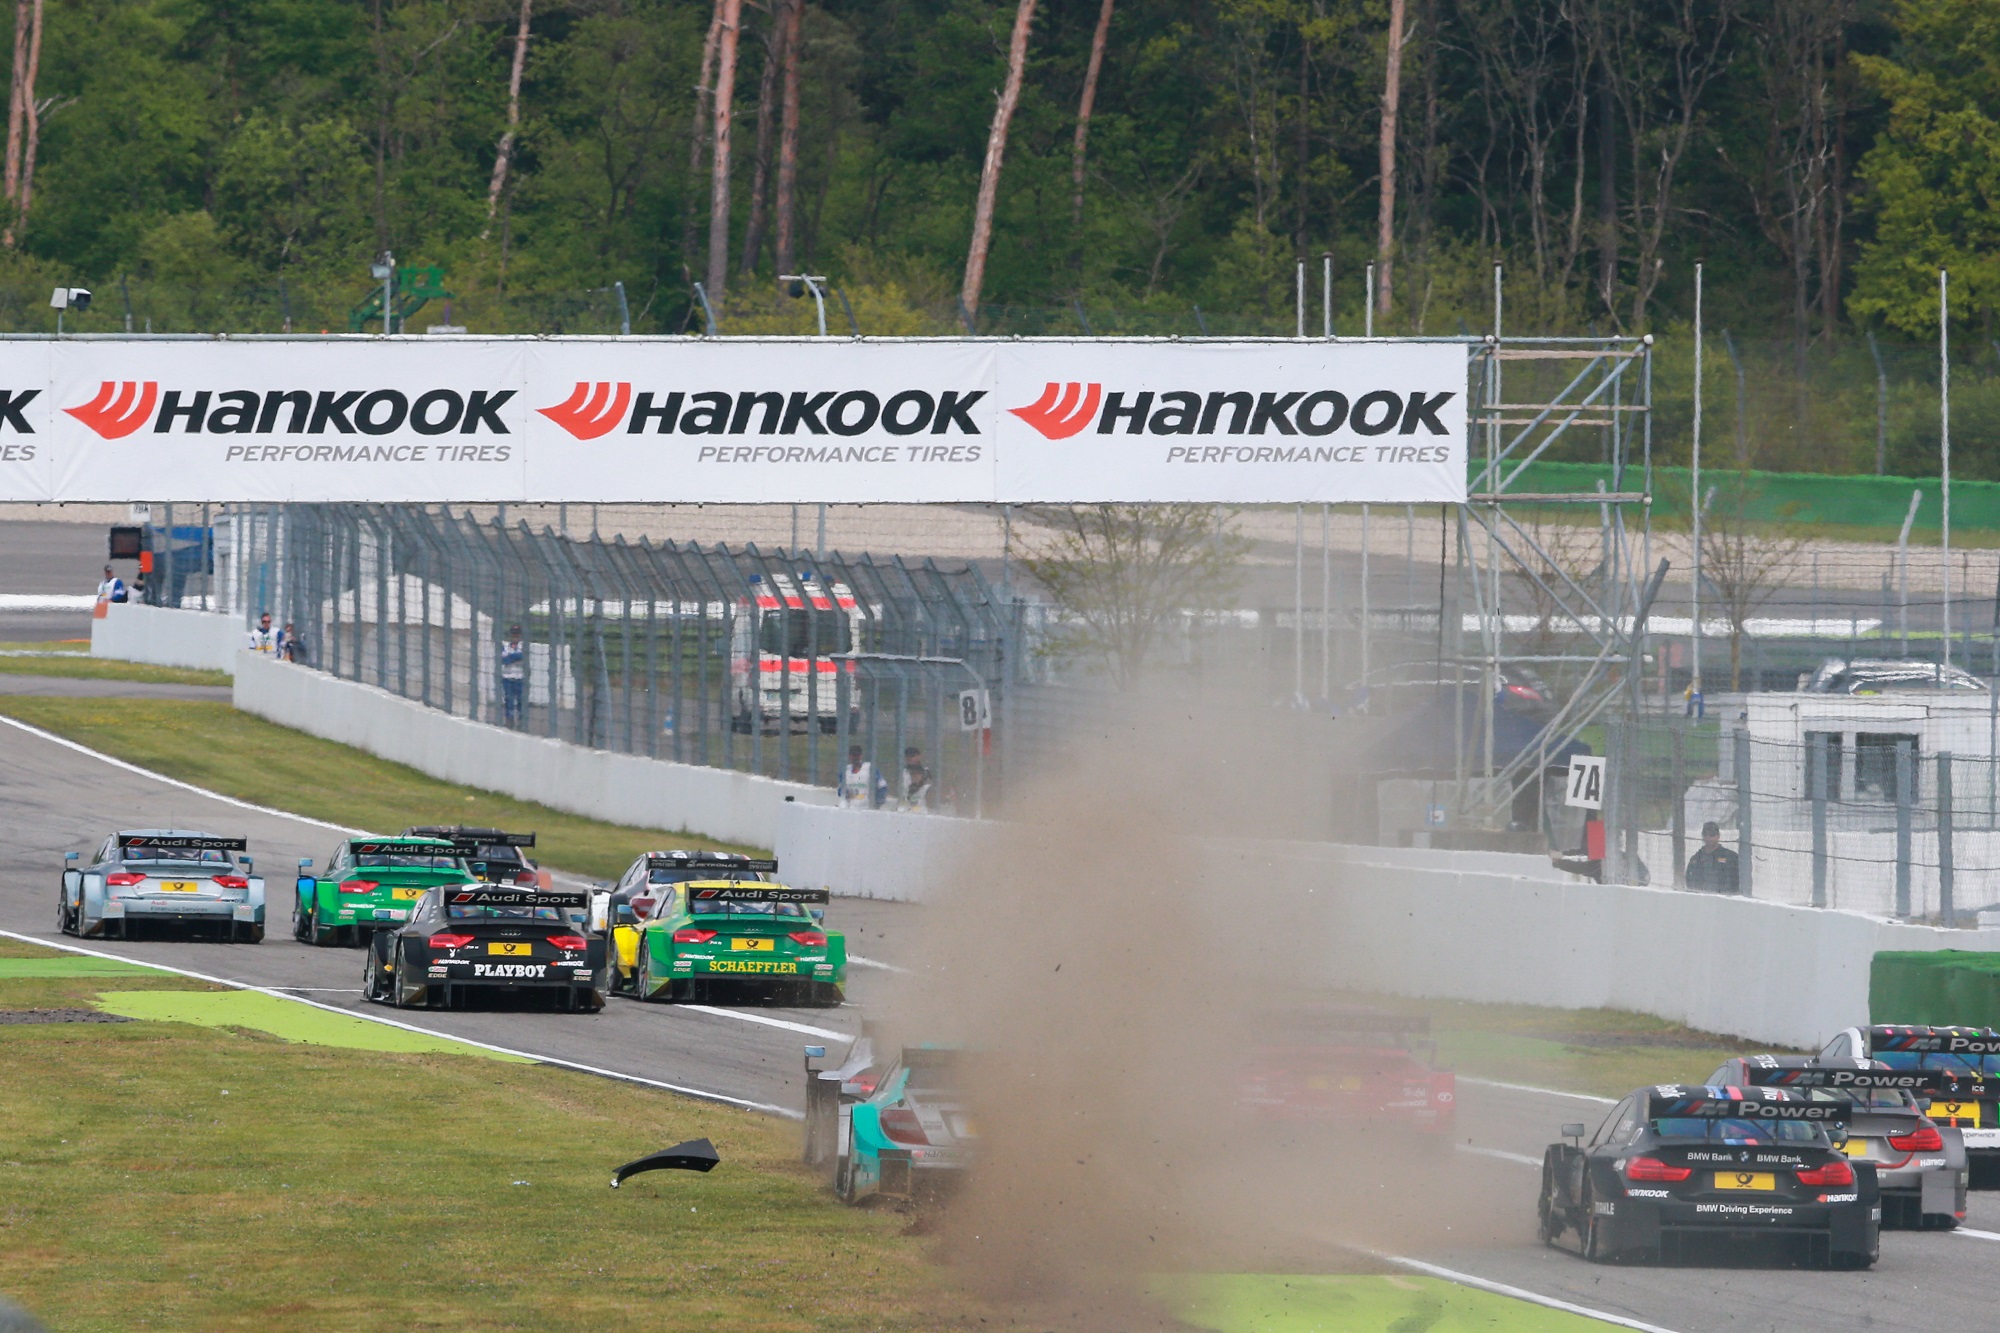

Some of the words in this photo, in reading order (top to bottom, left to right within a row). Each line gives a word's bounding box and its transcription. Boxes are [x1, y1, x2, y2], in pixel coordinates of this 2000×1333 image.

[0, 444, 37, 461] ES
[225, 445, 428, 462] PERFORMANCE
[436, 445, 512, 462] TIRES
[698, 446, 899, 463] PERFORMANCE
[907, 445, 982, 463] TIRES
[1166, 446, 1367, 463] PERFORMANCE
[1375, 446, 1450, 463] TIRES
[962, 695, 987, 726] 8
[1573, 763, 1600, 802] 7A
[148, 837, 188, 847] Audi
[191, 838, 240, 850] Sport
[381, 843, 419, 855] Audi
[423, 844, 472, 857] Sport
[477, 893, 521, 904] Audi
[525, 894, 579, 906] Sport
[719, 890, 764, 901] Audi
[767, 890, 820, 903] Sport
[474, 963, 547, 978] PLAYBOY
[709, 960, 797, 974] SCHAEFFLER
[1833, 1071, 1929, 1088] Power
[1737, 1100, 1838, 1119] Power
[1687, 1152, 1710, 1161] BMW
[1711, 1152, 1733, 1162] Bank
[1756, 1154, 1780, 1163] BMW
[1780, 1154, 1802, 1164] Bank
[1696, 1203, 1719, 1213] BMW
[1719, 1203, 1748, 1216] Driving
[1749, 1204, 1793, 1216] Experience
